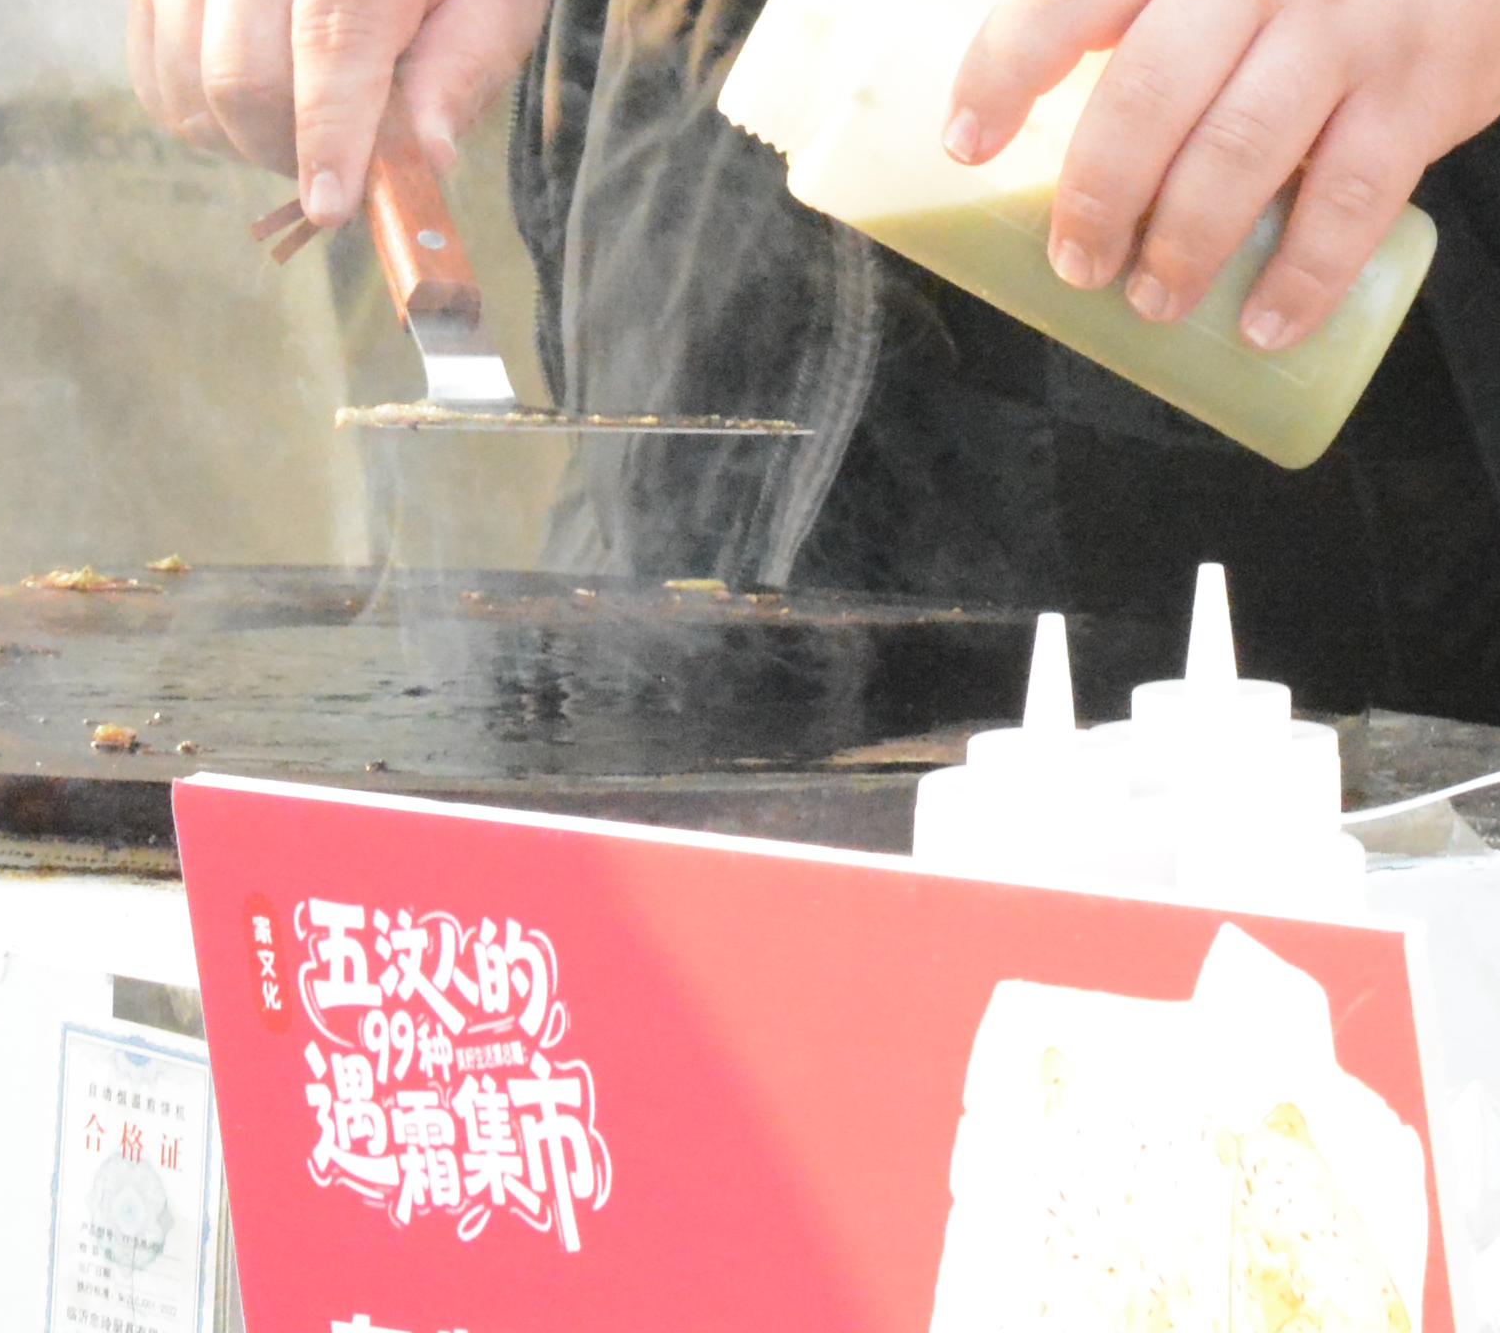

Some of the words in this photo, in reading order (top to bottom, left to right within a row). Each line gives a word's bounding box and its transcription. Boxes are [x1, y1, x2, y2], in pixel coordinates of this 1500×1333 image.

[308, 898, 548, 1036] 五汶人的
[83, 1112, 184, 1172] 合格证
[303, 1039, 598, 1252] 遇霜集市
